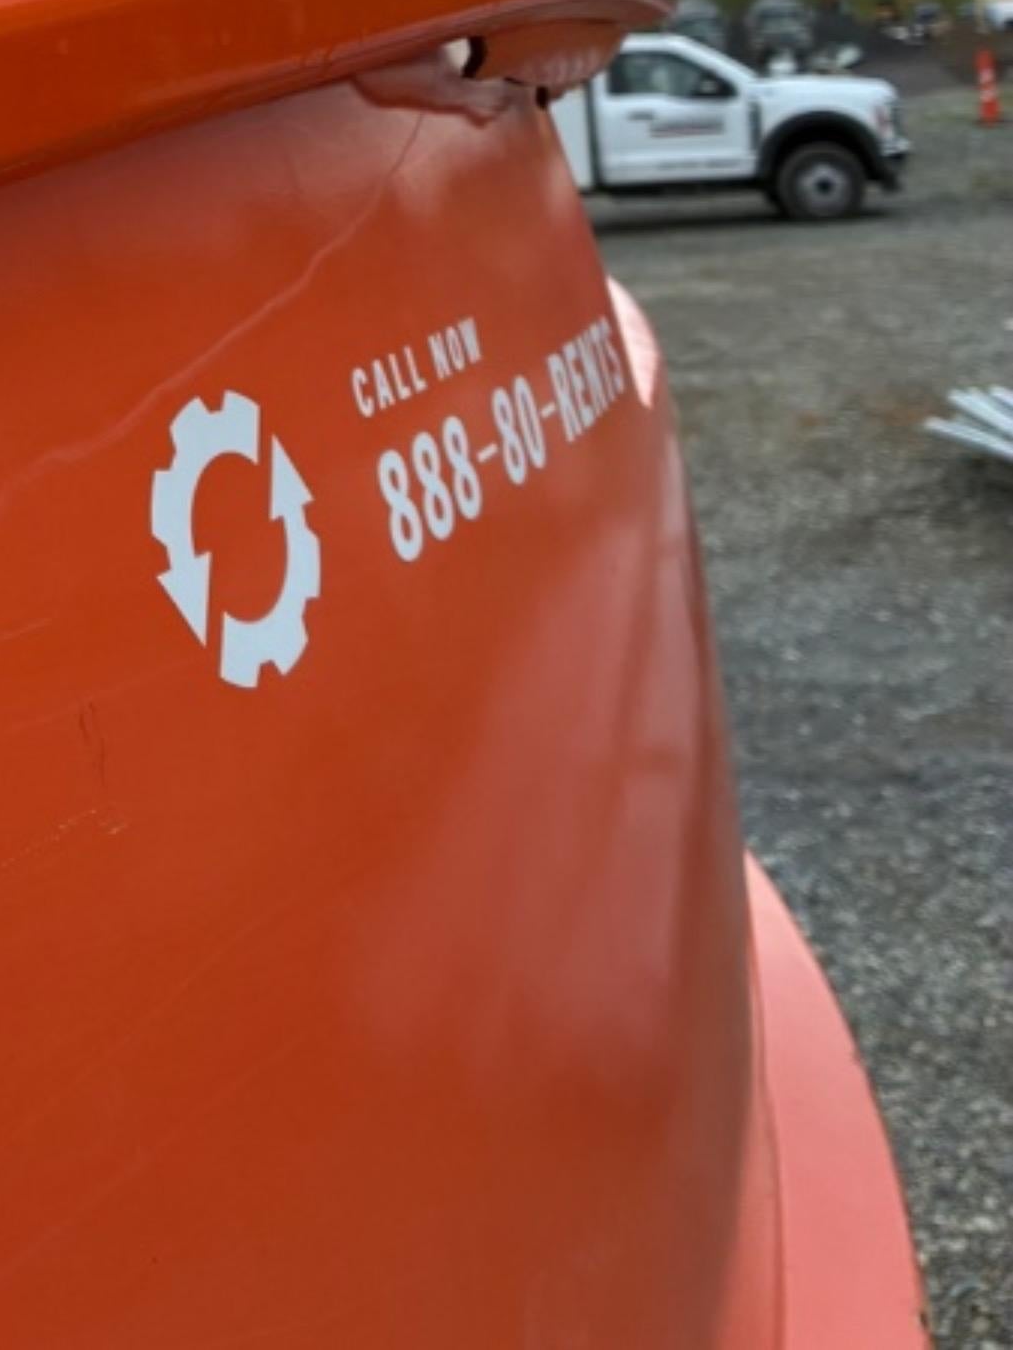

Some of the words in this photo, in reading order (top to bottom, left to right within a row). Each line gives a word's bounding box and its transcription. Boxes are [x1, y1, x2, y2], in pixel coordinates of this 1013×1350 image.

[351, 346, 428, 418] CALL
[427, 316, 483, 380] NOW
[377, 315, 625, 562] 888-80-RENTS
